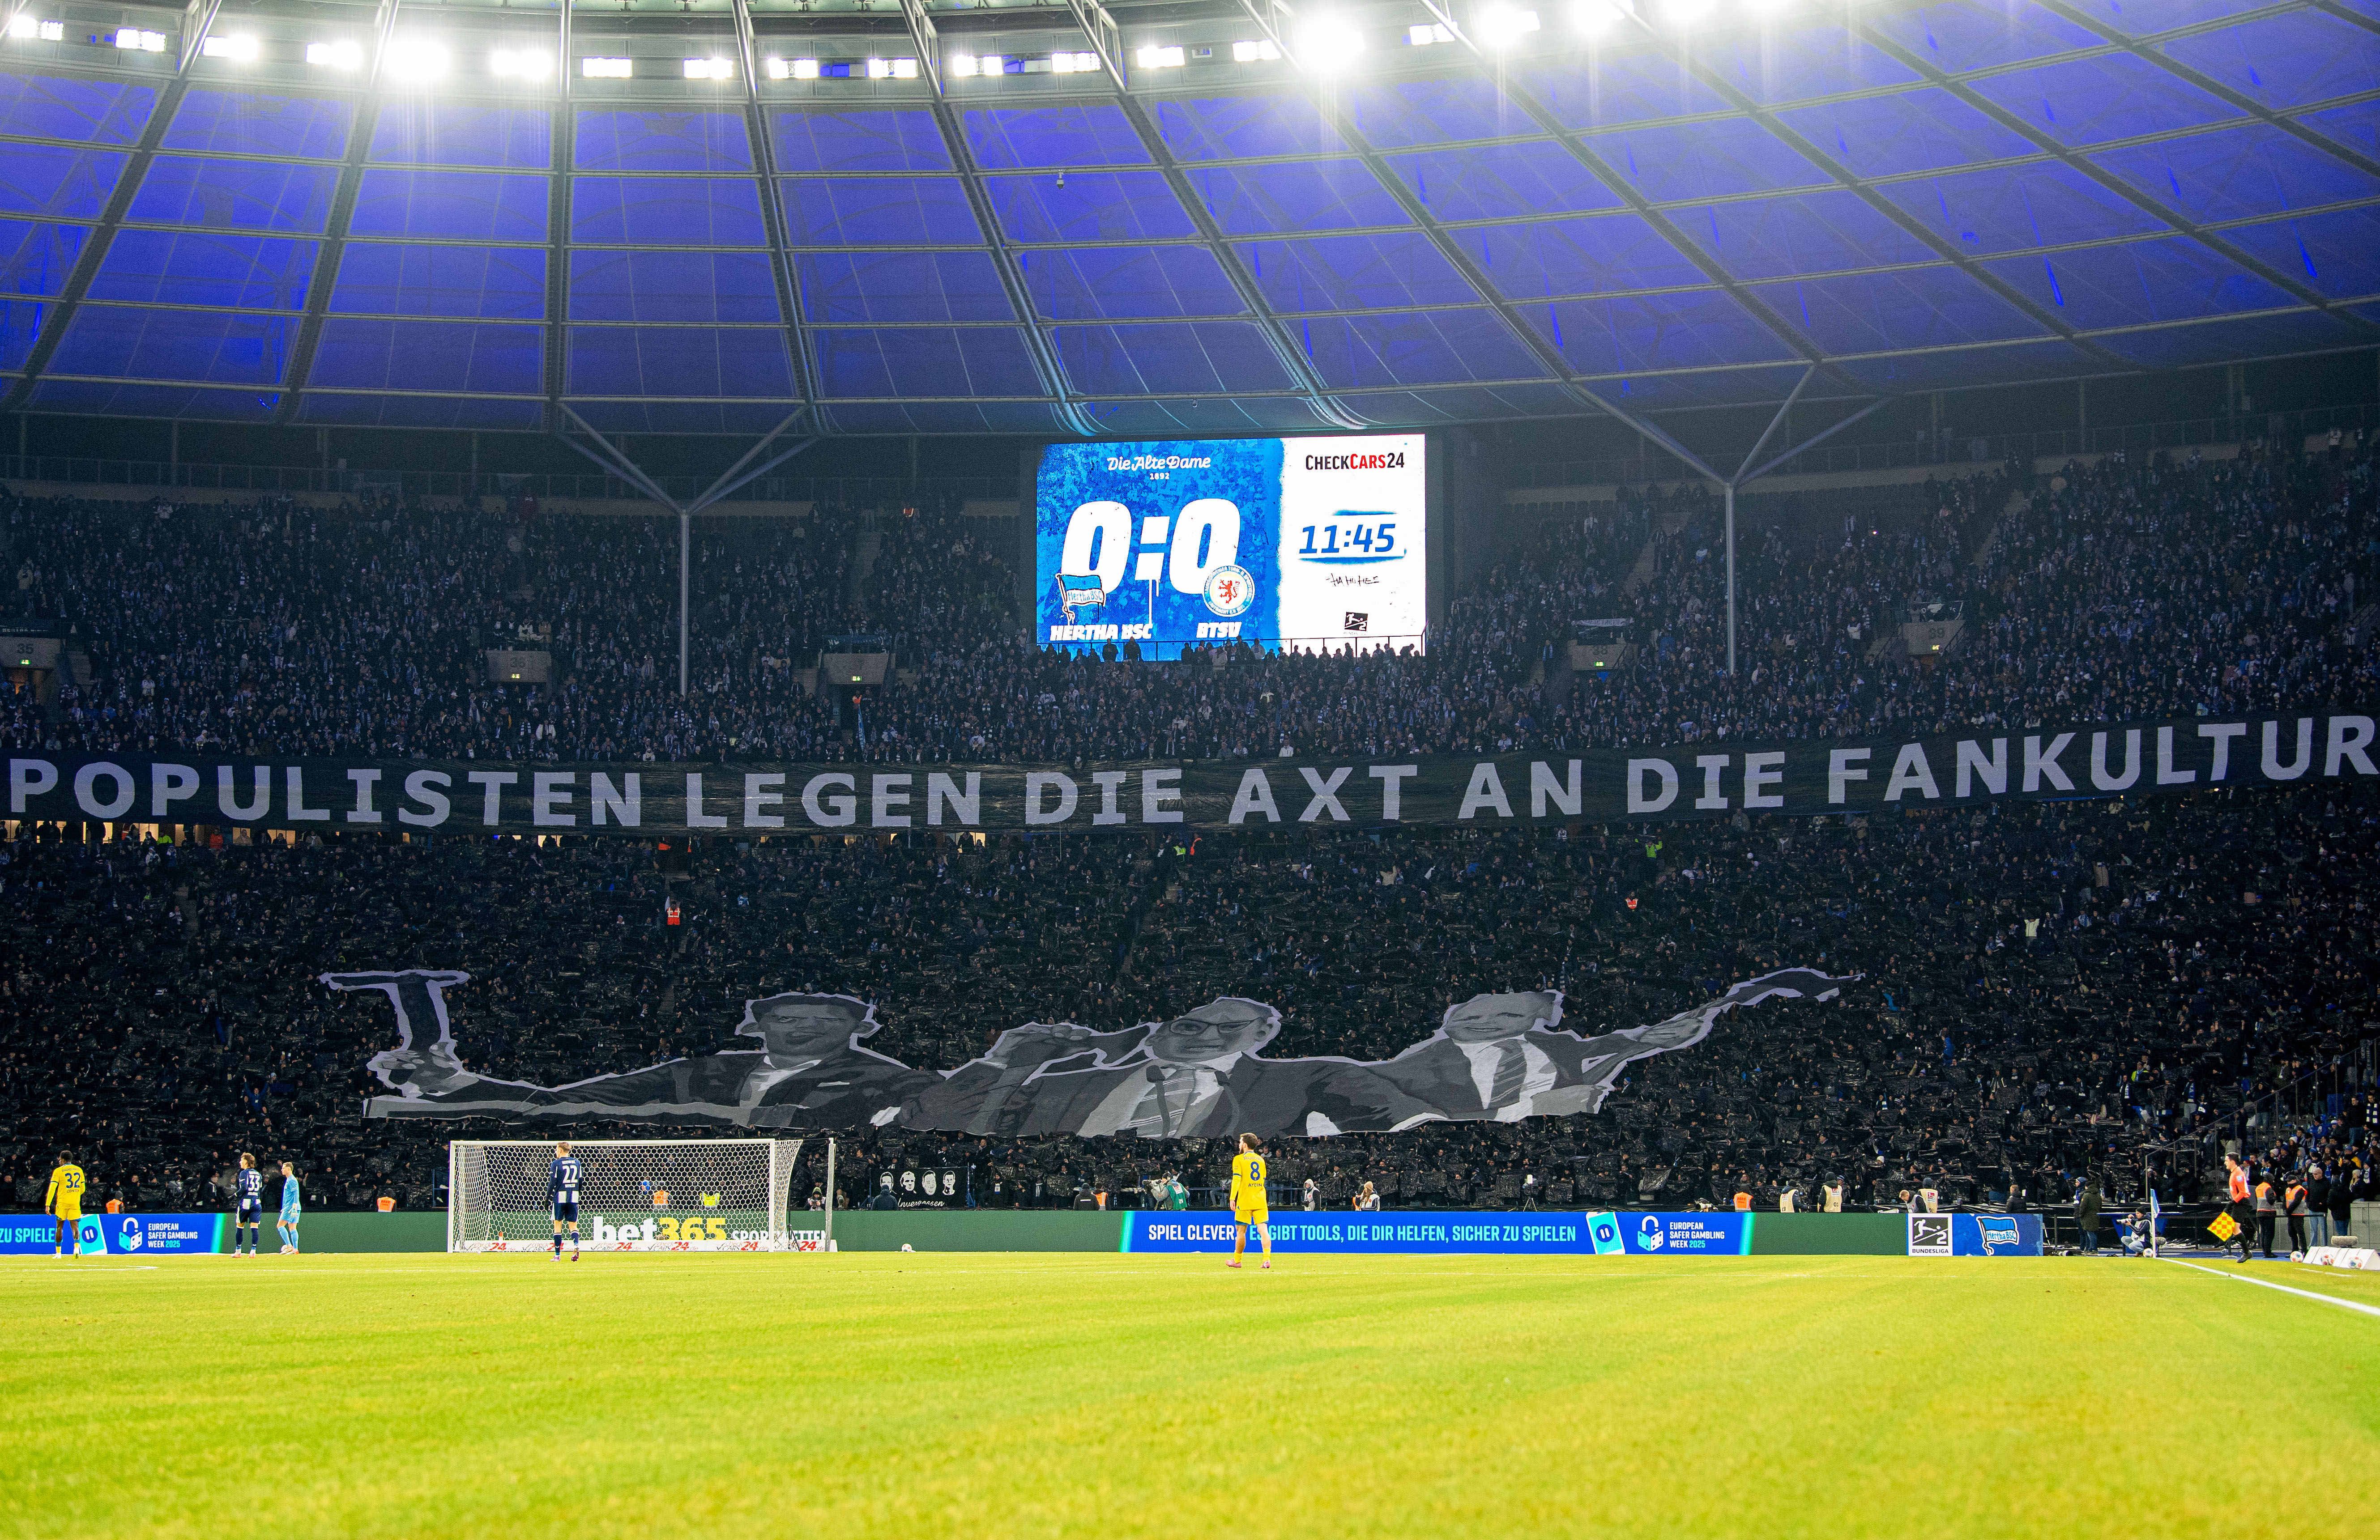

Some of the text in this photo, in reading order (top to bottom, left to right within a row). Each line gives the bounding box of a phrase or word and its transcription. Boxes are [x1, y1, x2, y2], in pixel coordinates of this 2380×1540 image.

[1107, 455, 1211, 471] Die Alte Dame
[1299, 523, 1395, 554] 11:45
[1050, 624, 1153, 641] HERTHA BSC
[1196, 621, 1242, 638] BTSV
[17, 643, 34, 654] 35
[10, 715, 2380, 828] POPULISTEN LEGEN DIE AXT AN DIE FANKULTUR
[562, 1165, 578, 1183] 22
[1250, 1161, 1260, 1181] 8
[65, 1172, 81, 1188] 32
[248, 1174, 260, 1191] 33
[593, 1216, 727, 1241] bet365
[1148, 1225, 1184, 1240] SPIEL
[1269, 1225, 1297, 1240] GIBT
[1300, 1225, 1344, 1243] TOOLS,
[1348, 1225, 1368, 1241] DIE
[1372, 1225, 1394, 1241] DIR
[1397, 1225, 1449, 1243] HELFEN,
[1452, 1225, 1500, 1241] SICHER
[1503, 1226, 1519, 1241] ZU
[1522, 1226, 1576, 1242] SPIELEN
[1669, 1222, 1703, 1230] EUROPEAN
[15, 1228, 55, 1242] SPIELE
[148, 1231, 198, 1239] SAFER GAMBLING
[1669, 1231, 1725, 1239] SAFER GAMBLING
[1988, 1231, 2016, 1241] Hertha BSC
[741, 1241, 759, 1251] 24
[800, 1241, 817, 1251] 24
